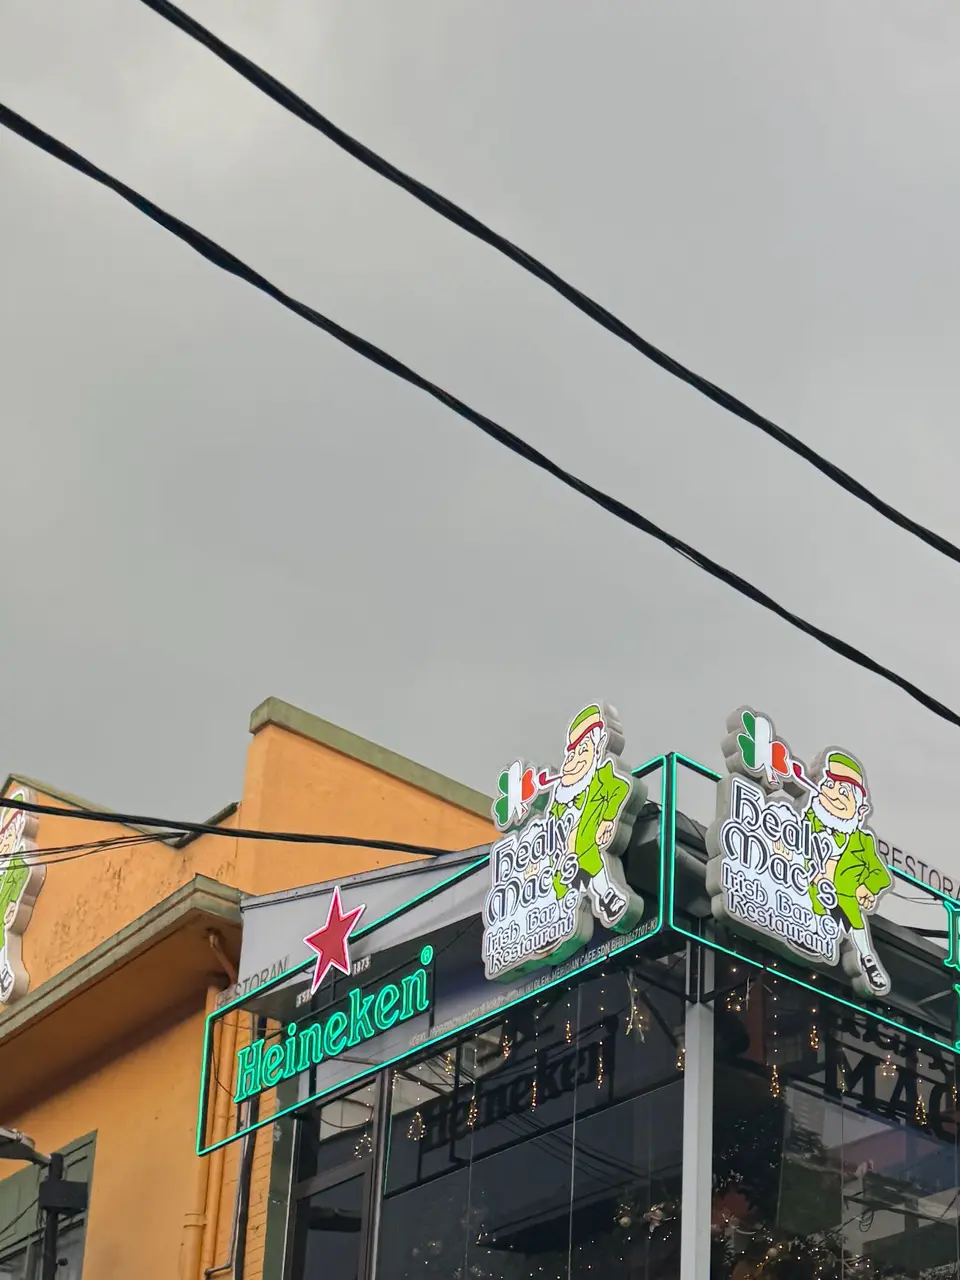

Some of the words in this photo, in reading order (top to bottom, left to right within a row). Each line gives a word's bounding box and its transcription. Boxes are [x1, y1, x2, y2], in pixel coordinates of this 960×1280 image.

[493, 814, 574, 885] Healy
[731, 778, 832, 873] Healy
[486, 853, 580, 925] Mac's
[721, 818, 838, 908] Mac's
[723, 863, 768, 906] Irish
[777, 891, 814, 926] Bar
[486, 920, 521, 957] Irish
[526, 903, 557, 934] Bar
[488, 911, 575, 975] Restaurant
[580, 949, 597, 967] CAFE
[728, 889, 836, 961] Restaurant
[233, 968, 430, 1104] Heineken
